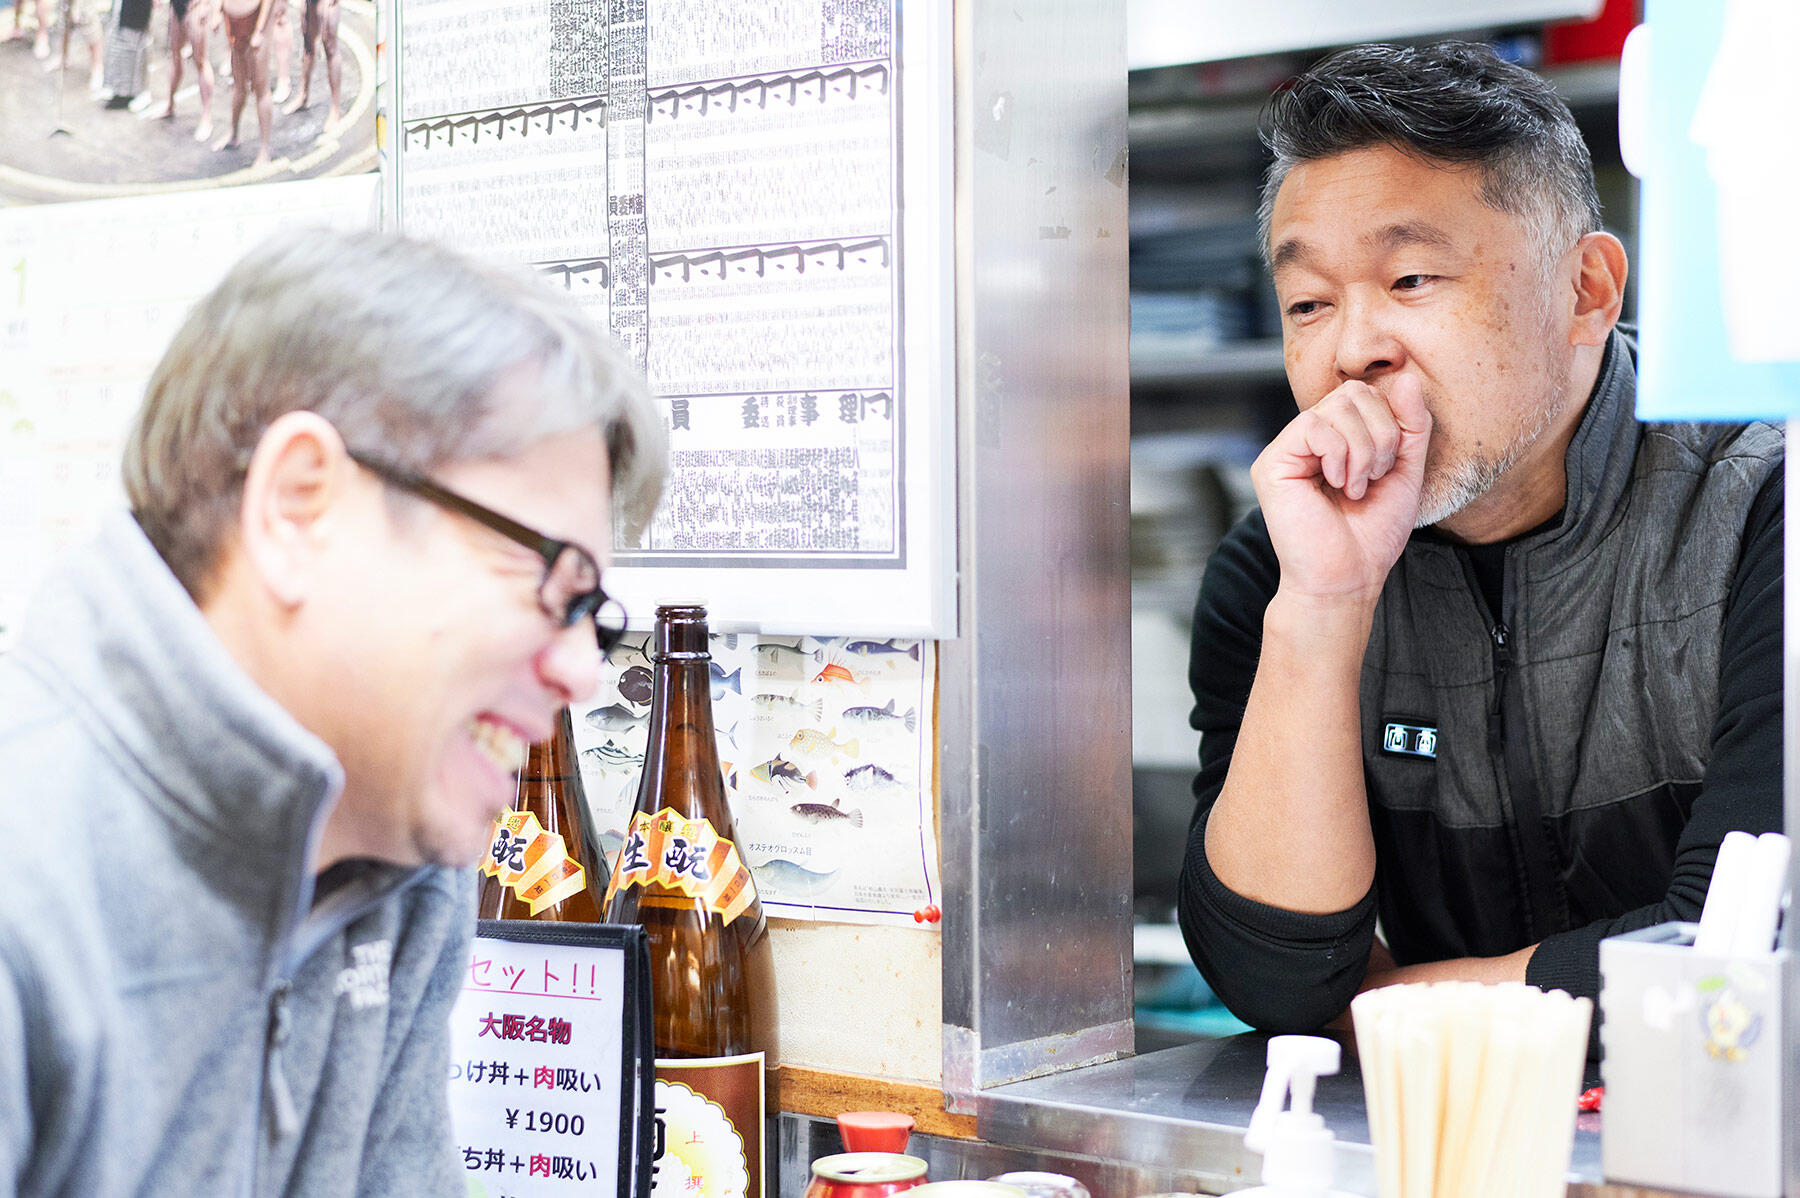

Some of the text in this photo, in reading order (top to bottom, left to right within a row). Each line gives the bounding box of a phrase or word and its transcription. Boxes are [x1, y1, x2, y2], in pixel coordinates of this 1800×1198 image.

[478, 1012, 573, 1045] 大阪名物
[505, 1107, 586, 1136] ¥1900
